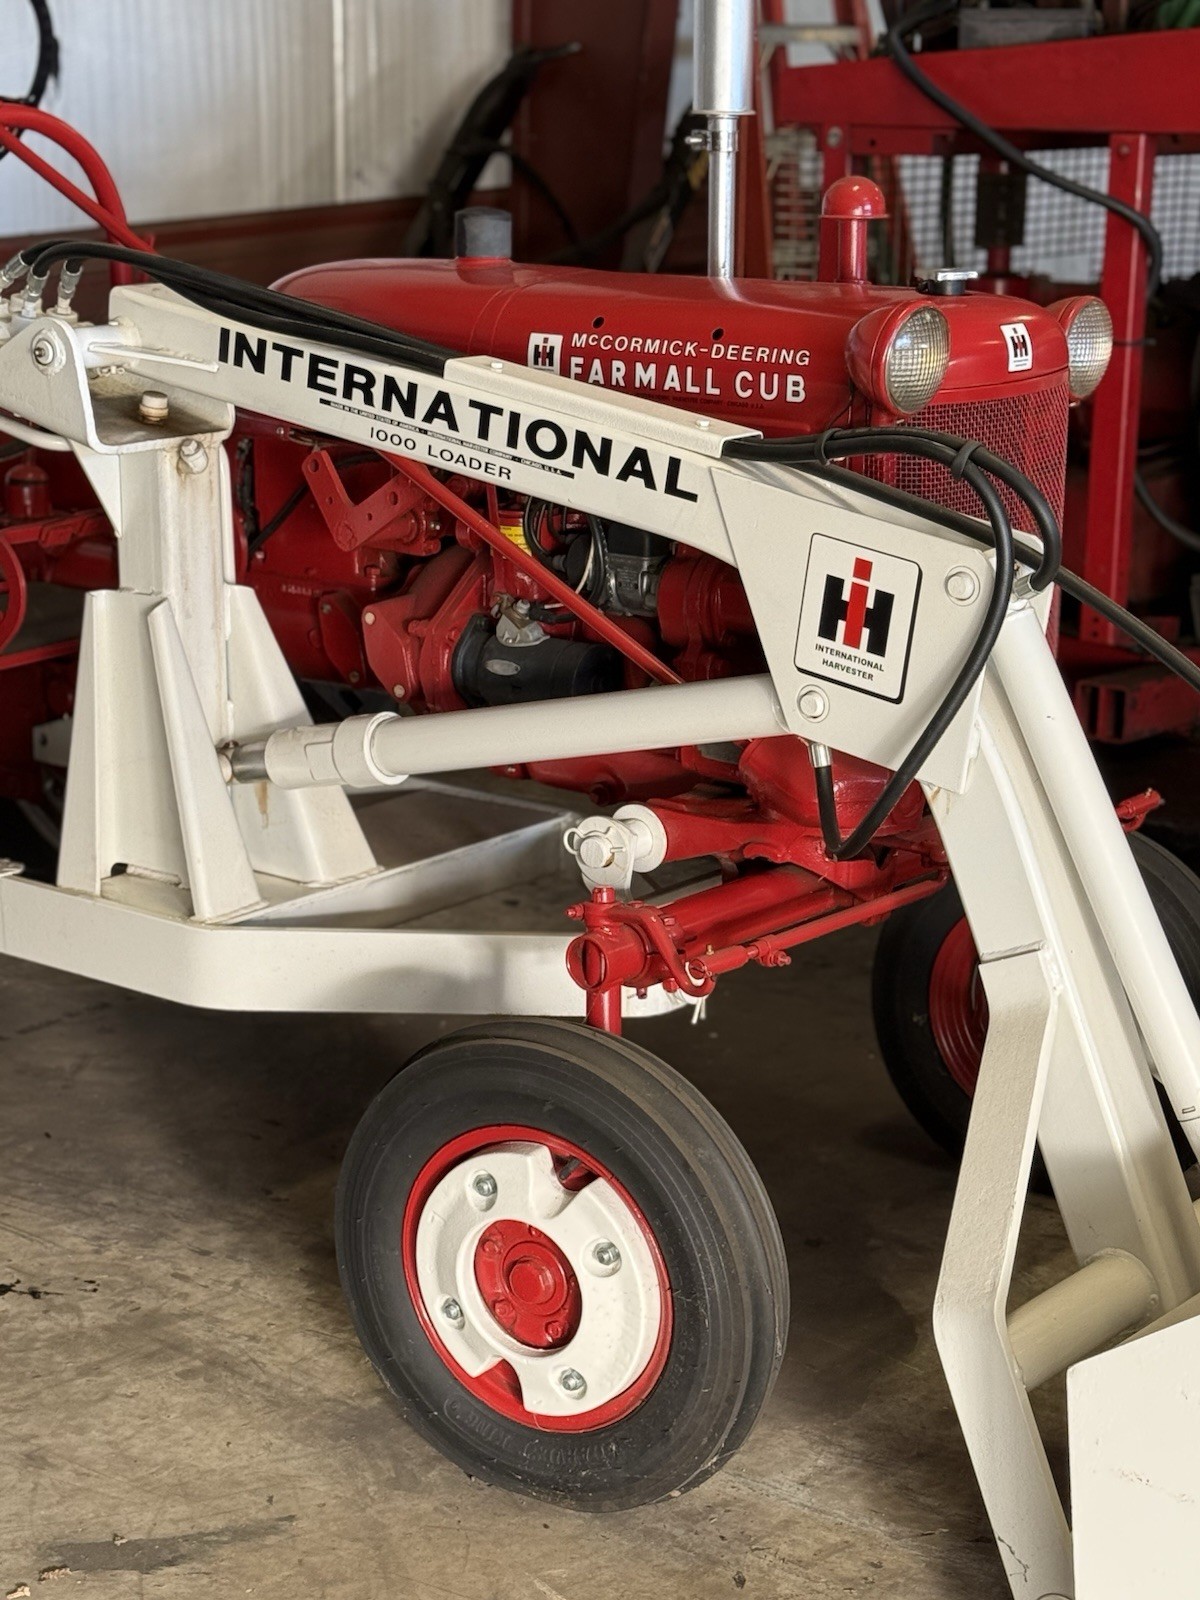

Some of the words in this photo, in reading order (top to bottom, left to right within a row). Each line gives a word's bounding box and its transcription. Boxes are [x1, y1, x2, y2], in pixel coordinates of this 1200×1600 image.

[571, 332, 811, 366] McCORMICK-DEERING
[570, 356, 721, 395] FARMALL
[735, 370, 806, 403] CUB
[218, 327, 699, 503] INTERNATIONAL
[370, 426, 416, 451] 1000
[427, 444, 511, 480] LOADER
[815, 643, 885, 672] INTERNATIONAL
[822, 658, 874, 681] HARVESTER
